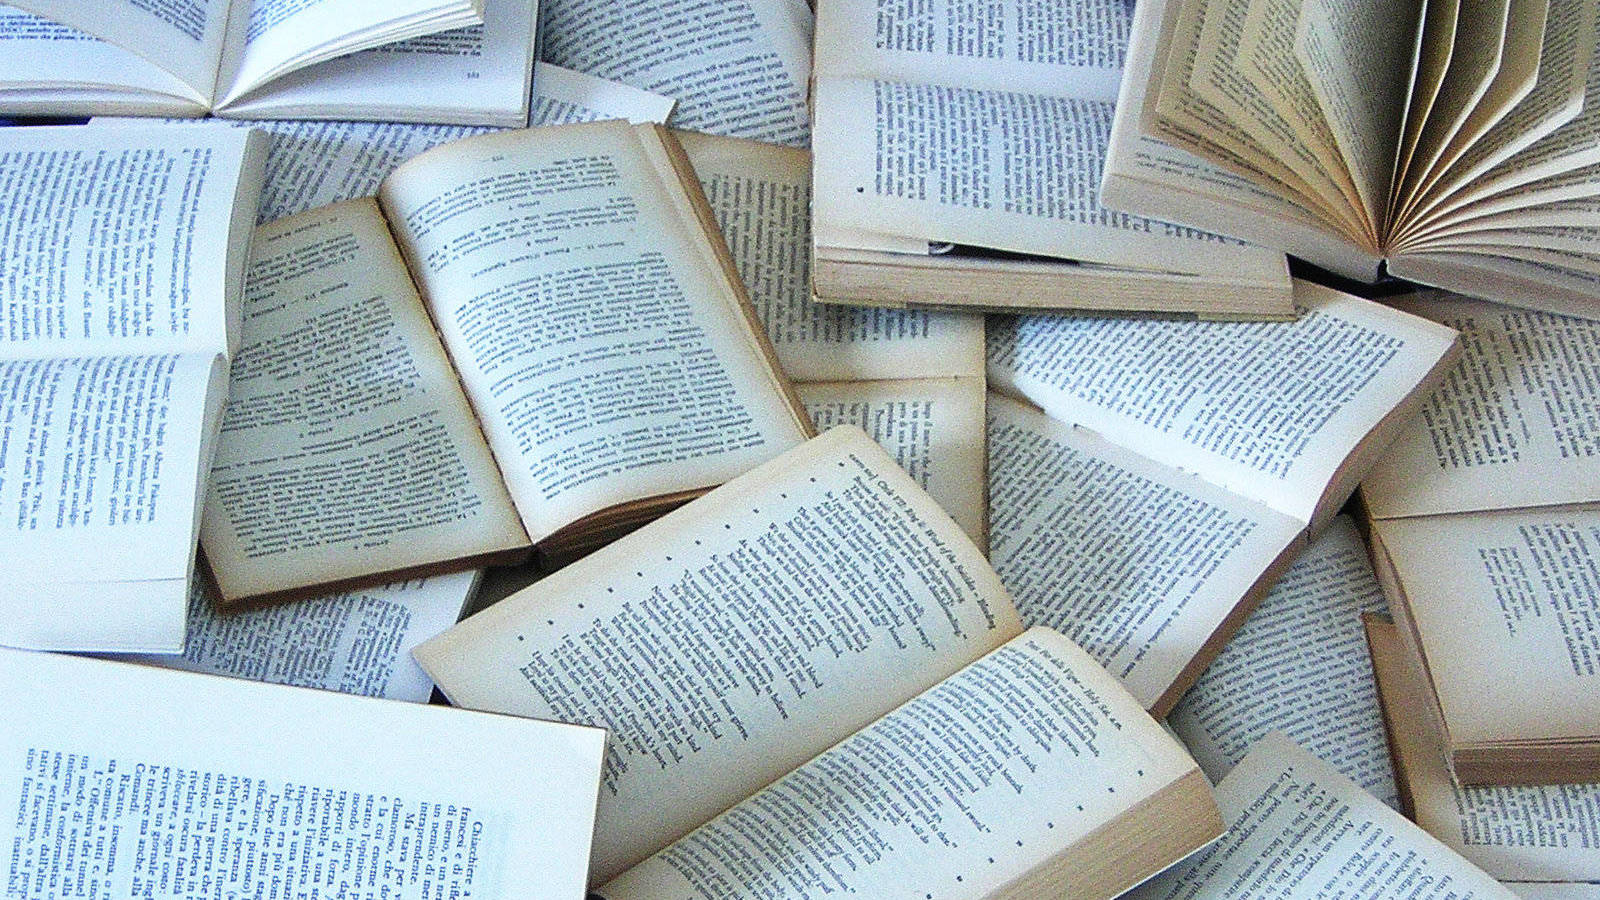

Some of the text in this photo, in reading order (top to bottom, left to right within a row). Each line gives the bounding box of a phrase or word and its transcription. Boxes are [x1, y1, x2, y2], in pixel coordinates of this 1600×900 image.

[51, 752, 62, 780] stesse
[108, 759, 116, 773] sta
[100, 777, 114, 821] comune
[129, 763, 146, 815] Comandi.
[184, 770, 199, 814] rivelarsi
[213, 798, 223, 809] di
[241, 778, 252, 803] gere,
[294, 785, 308, 826] rispetto
[447, 805, 457, 816] di
[27, 782, 45, 844] si facevano,
[41, 785, 57, 839] settimane,
[49, 754, 76, 888] insieme, la conformistica
[62, 756, 89, 897] un modo di sottrarsi alla
[105, 774, 131, 876] Riscatto, insomma,
[131, 765, 160, 897] le trincee ma anche, alla
[148, 767, 171, 876] scriveva un giornale
[187, 772, 211, 892] storico la perdeva in
[210, 813, 218, 833] una
[219, 776, 240, 864] ribellava contro
[237, 822, 248, 831] la
[272, 783, 295, 871] ché non era più
[318, 789, 335, 847] riportabile
[341, 792, 360, 873] mondo intero,
[374, 822, 384, 840] cui
[378, 808, 389, 817] la
[456, 807, 471, 848] francesi
[75, 787, 100, 897] Offensiva dei tunnel
[94, 836, 105, 860] tutti
[163, 833, 174, 858] ogni
[179, 818, 190, 852] oscura
[204, 836, 215, 872] guerra
[241, 780, 267, 894] sificazione, piuttosto)
[258, 794, 280, 876] Dopo due anni
[289, 841, 298, 861] una
[299, 787, 320, 887] riavere l'iniziativa.
[327, 791, 347, 887] rapporti di forza.
[353, 794, 374, 889] stratto l'opinione
[383, 797, 403, 879] clamoroso, che
[394, 813, 415, 887] Ma stava per
[410, 802, 428, 885] intraprendente.
[425, 804, 441, 875] un nemico di
[441, 820, 453, 853] meno,
[465, 821, 483, 885] Chiacchiere
[159, 862, 170, 894] costo:
[230, 837, 243, 883] speranza
[313, 863, 322, 883] una
[368, 845, 380, 887] enorme
[438, 866, 446, 881] un
[452, 864, 463, 875] di
[201, 874, 212, 894] che
